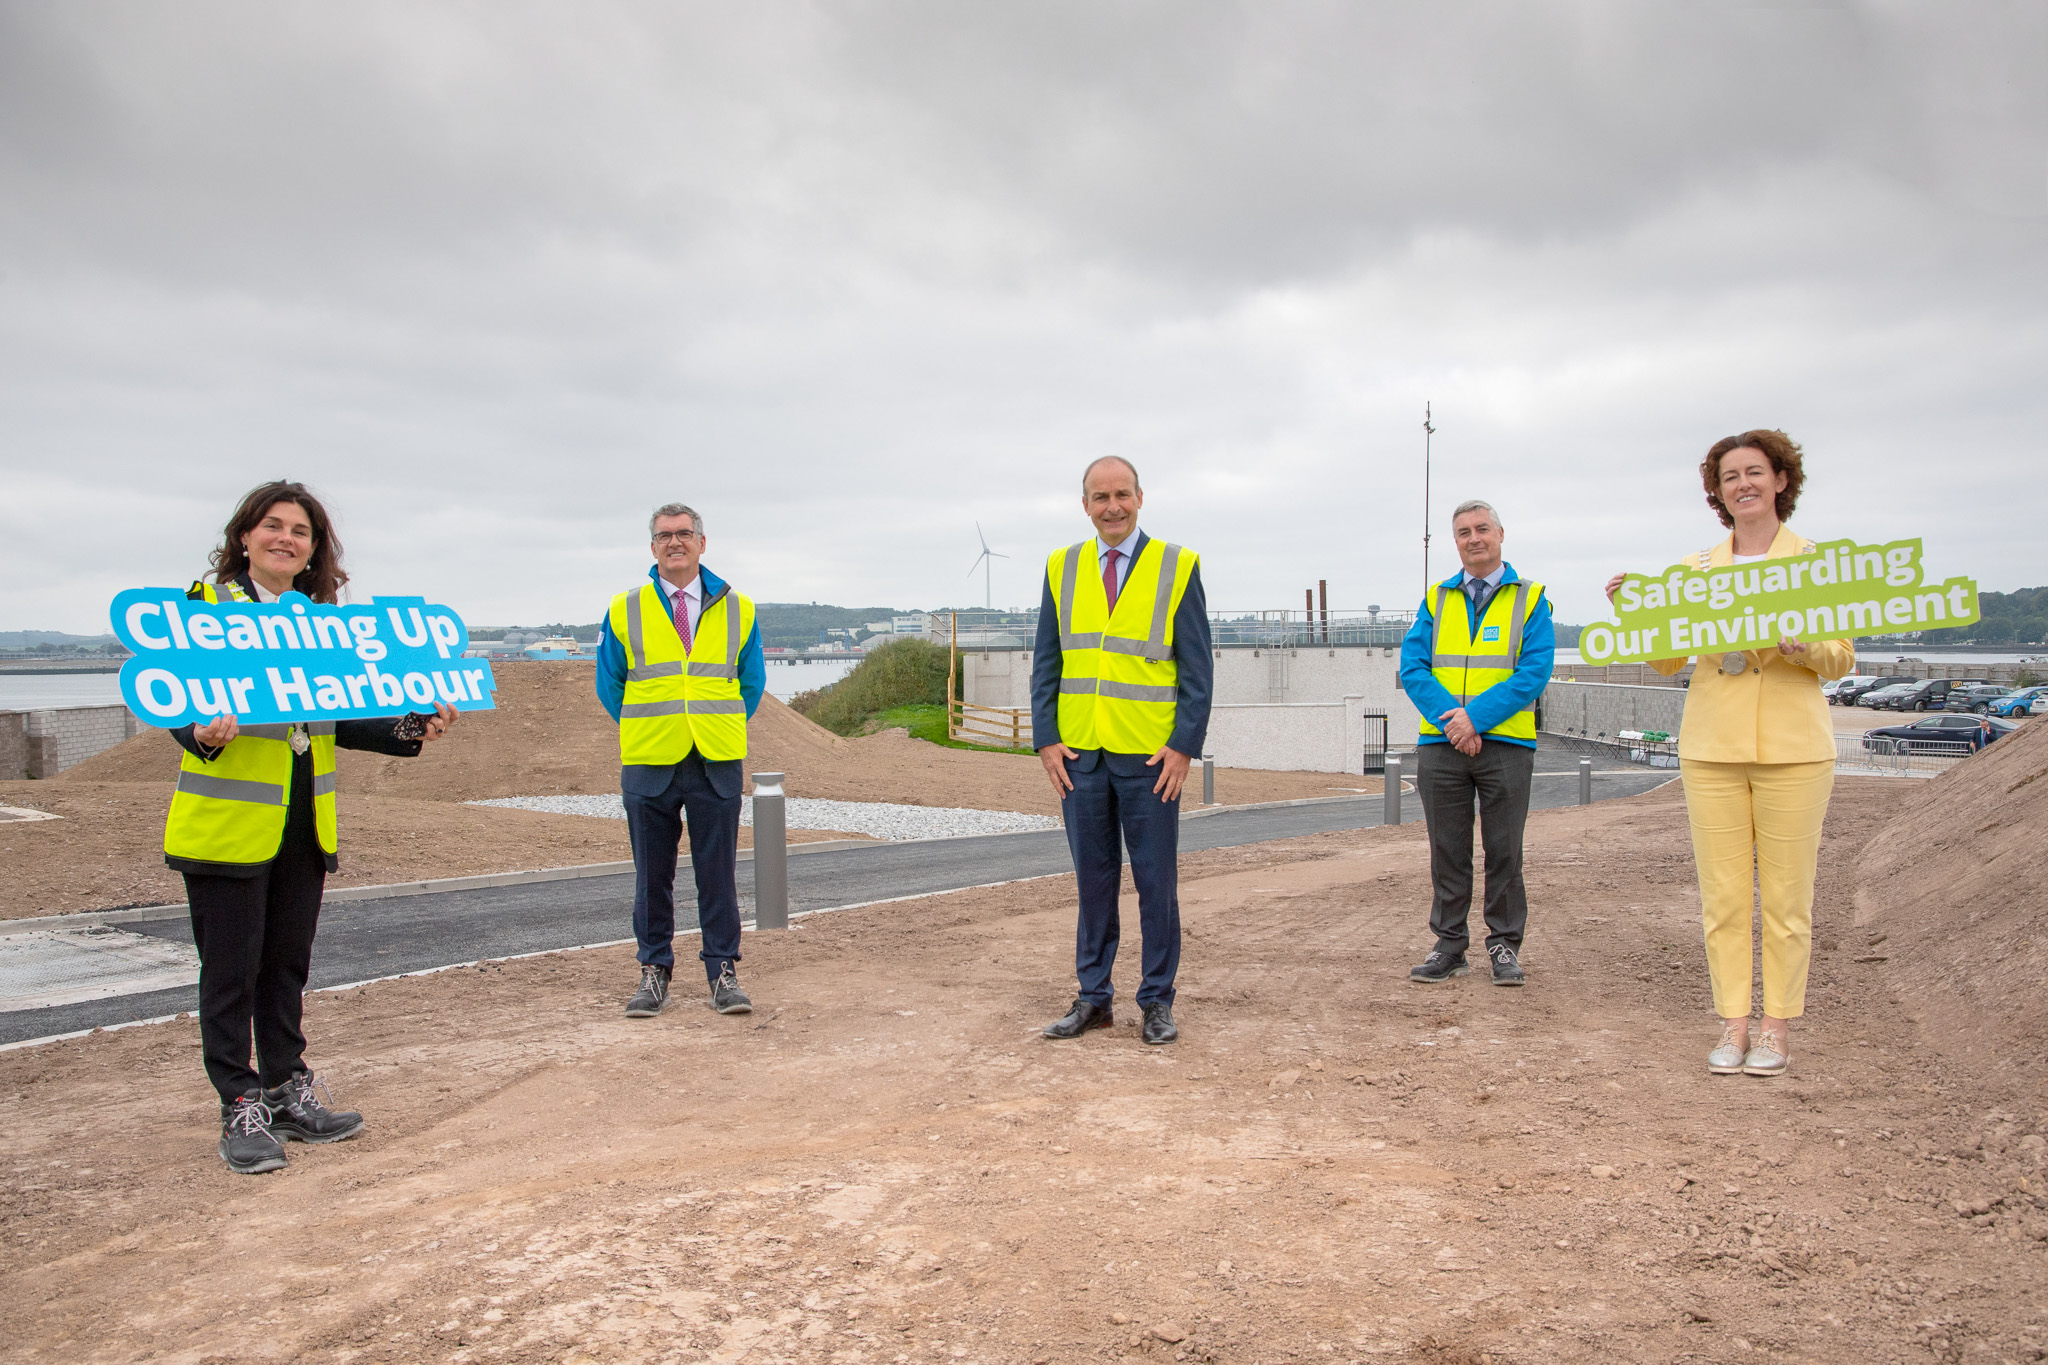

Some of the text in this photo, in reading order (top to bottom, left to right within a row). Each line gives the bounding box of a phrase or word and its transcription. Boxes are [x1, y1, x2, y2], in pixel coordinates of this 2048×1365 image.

[1620, 546, 1916, 613] Safeguarding
[125, 600, 460, 662] Cleaning Up
[1585, 584, 1971, 660] Our Environment
[134, 661, 484, 718] Our Harbour
